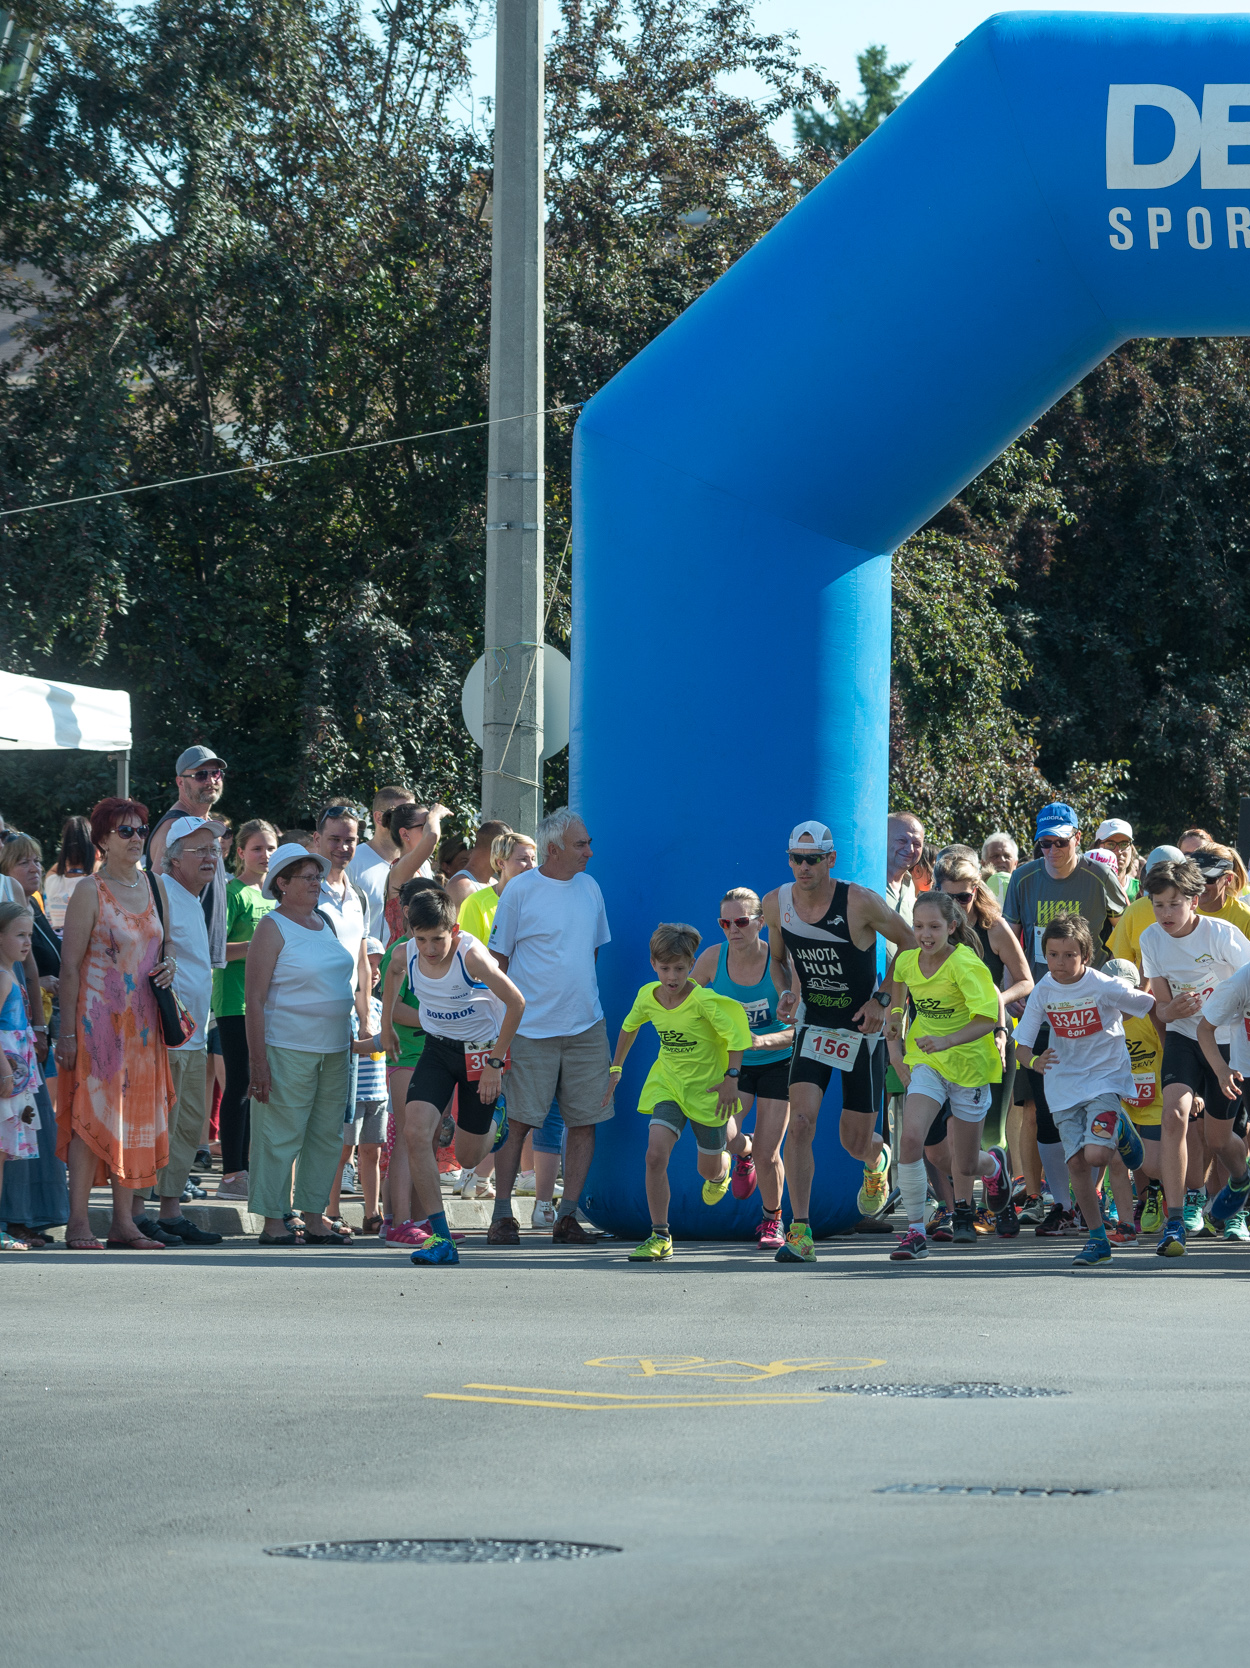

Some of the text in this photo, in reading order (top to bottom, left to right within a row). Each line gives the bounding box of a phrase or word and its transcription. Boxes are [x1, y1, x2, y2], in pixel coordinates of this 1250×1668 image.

[797, 948, 839, 962] JANOTA
[803, 961, 843, 976] HUN
[1053, 1010, 1096, 1028] 334/2
[812, 1036, 850, 1059] 156
